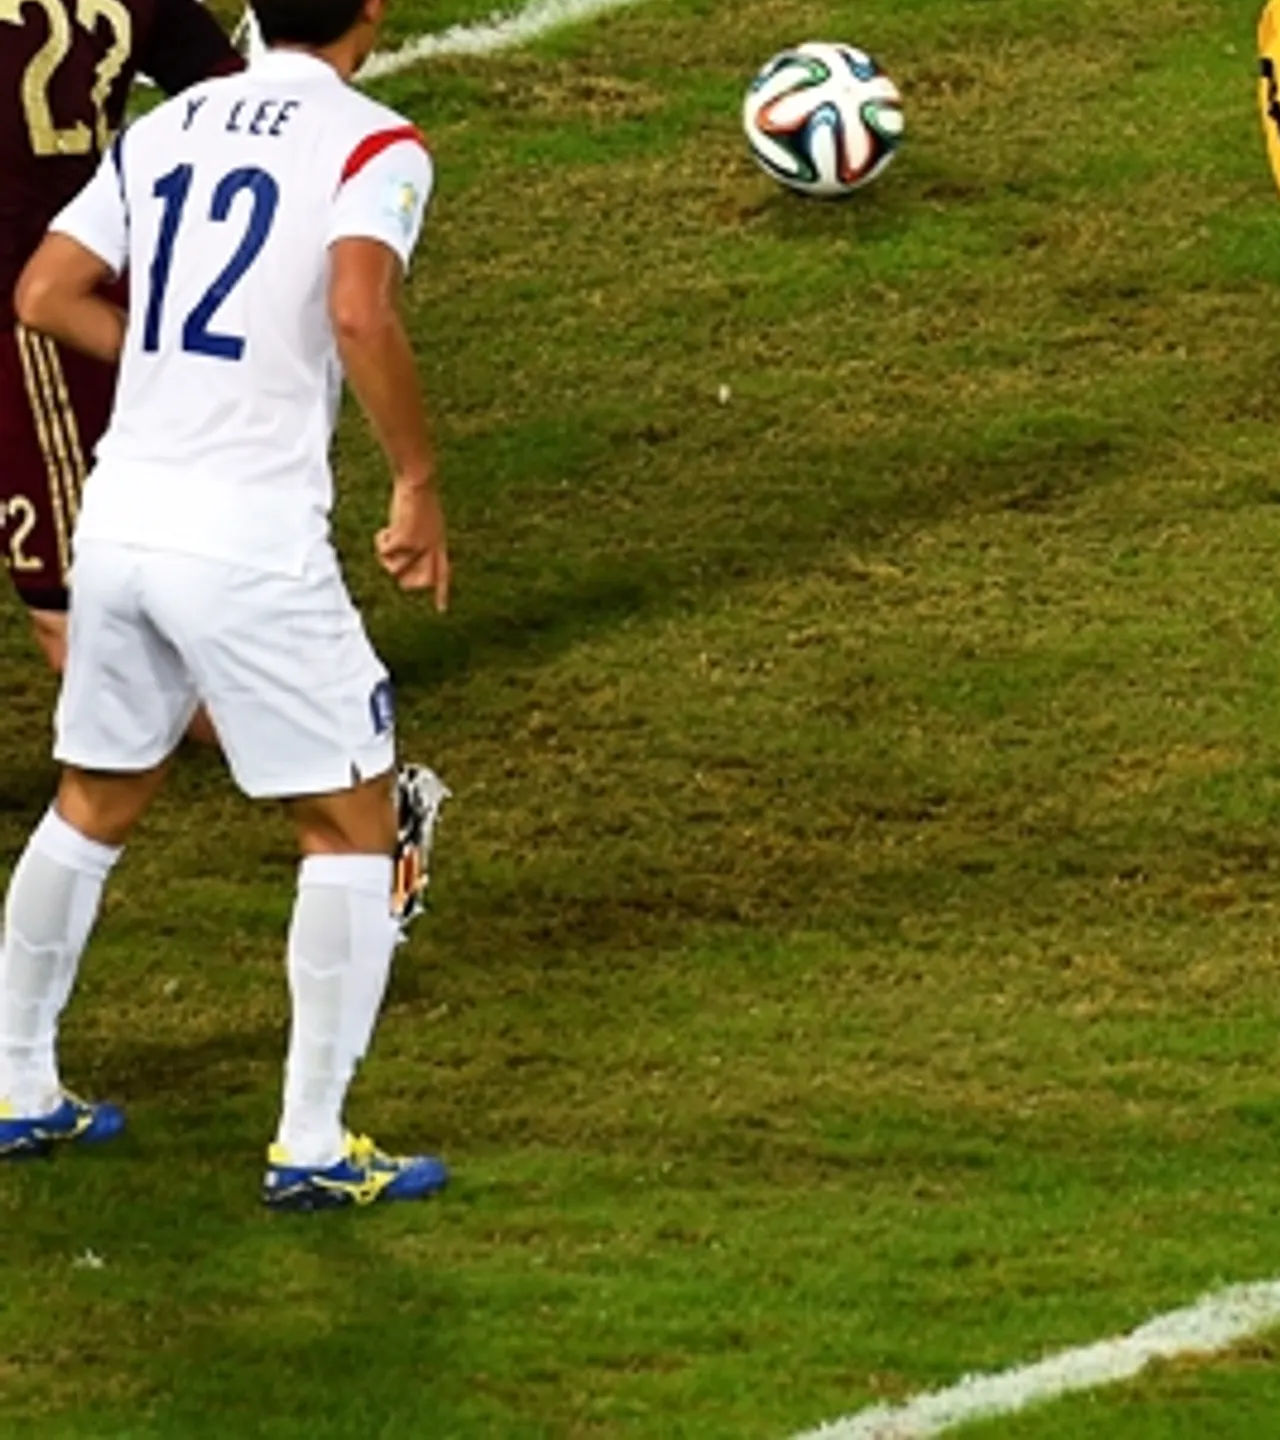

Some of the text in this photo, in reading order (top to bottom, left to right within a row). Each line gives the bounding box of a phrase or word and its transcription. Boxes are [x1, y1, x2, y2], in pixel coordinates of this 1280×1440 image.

[182, 95, 300, 136] Y LEE
[142, 162, 280, 361] 12
[0, 494, 45, 570] 2
